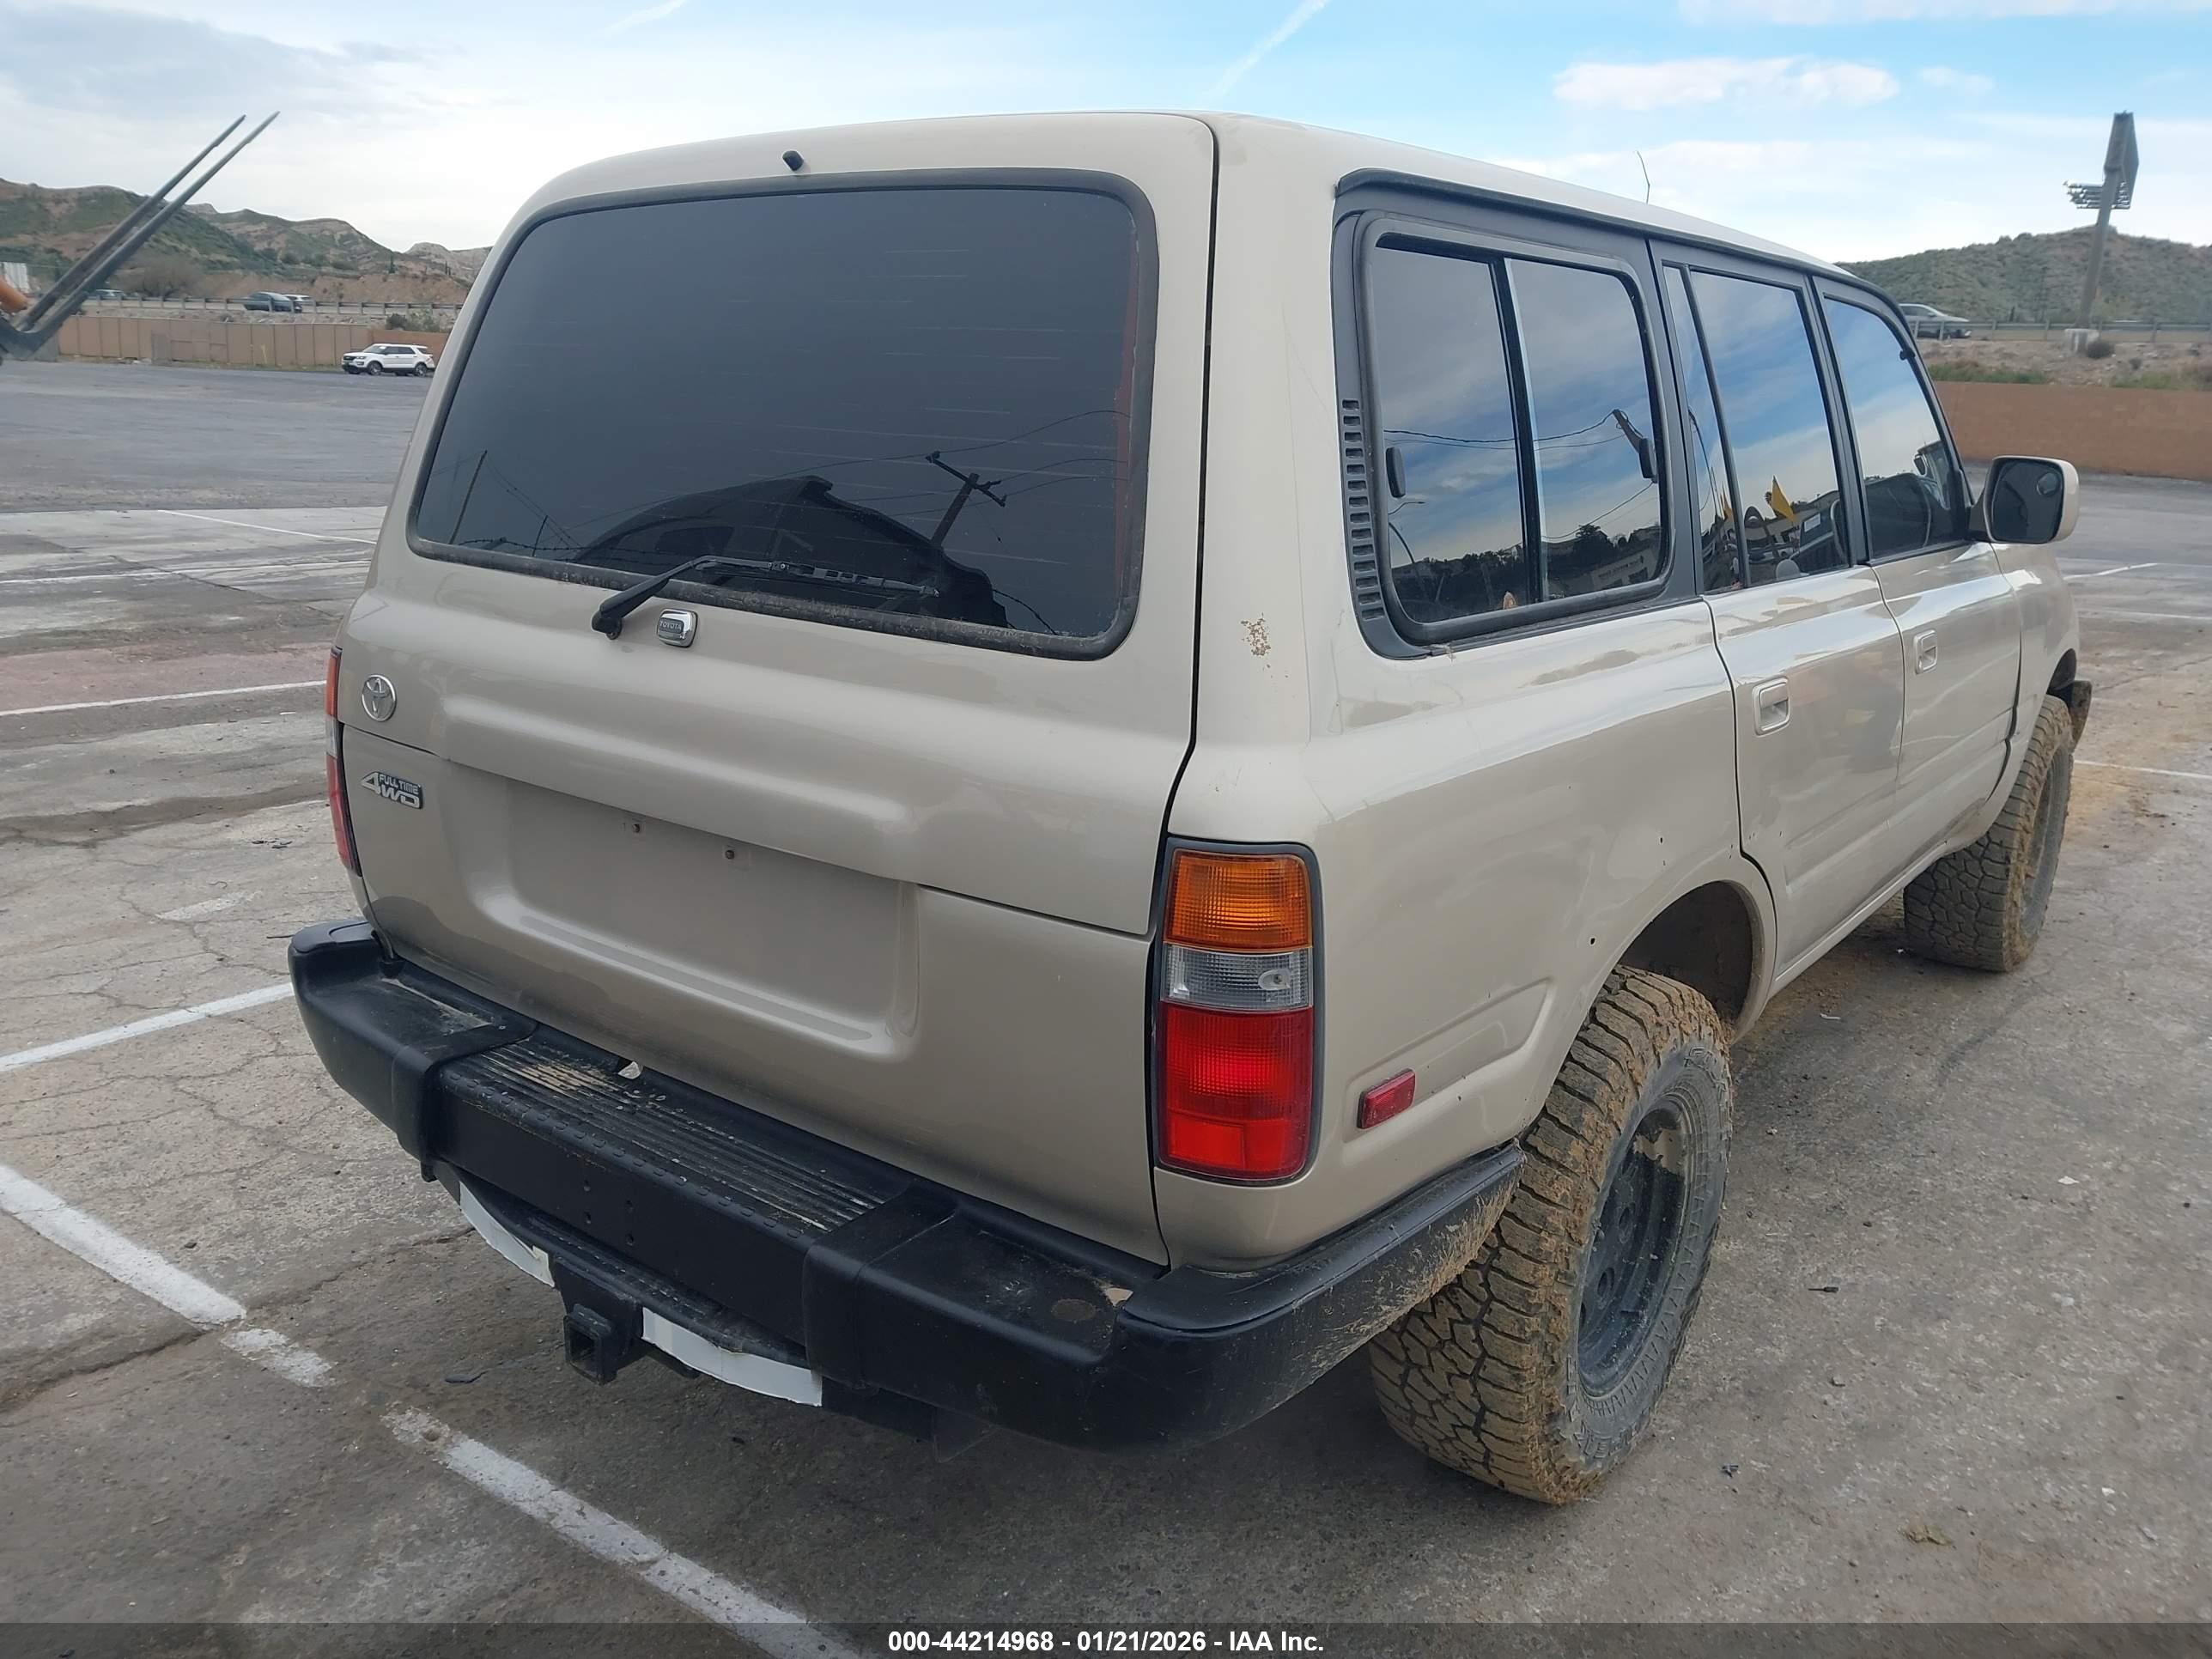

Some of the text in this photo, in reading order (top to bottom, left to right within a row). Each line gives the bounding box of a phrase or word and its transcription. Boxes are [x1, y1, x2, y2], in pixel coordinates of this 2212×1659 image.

[659, 620, 682, 631] TOYOTA
[360, 772, 421, 809] 4WD
[379, 774, 419, 795] FULL TIME
